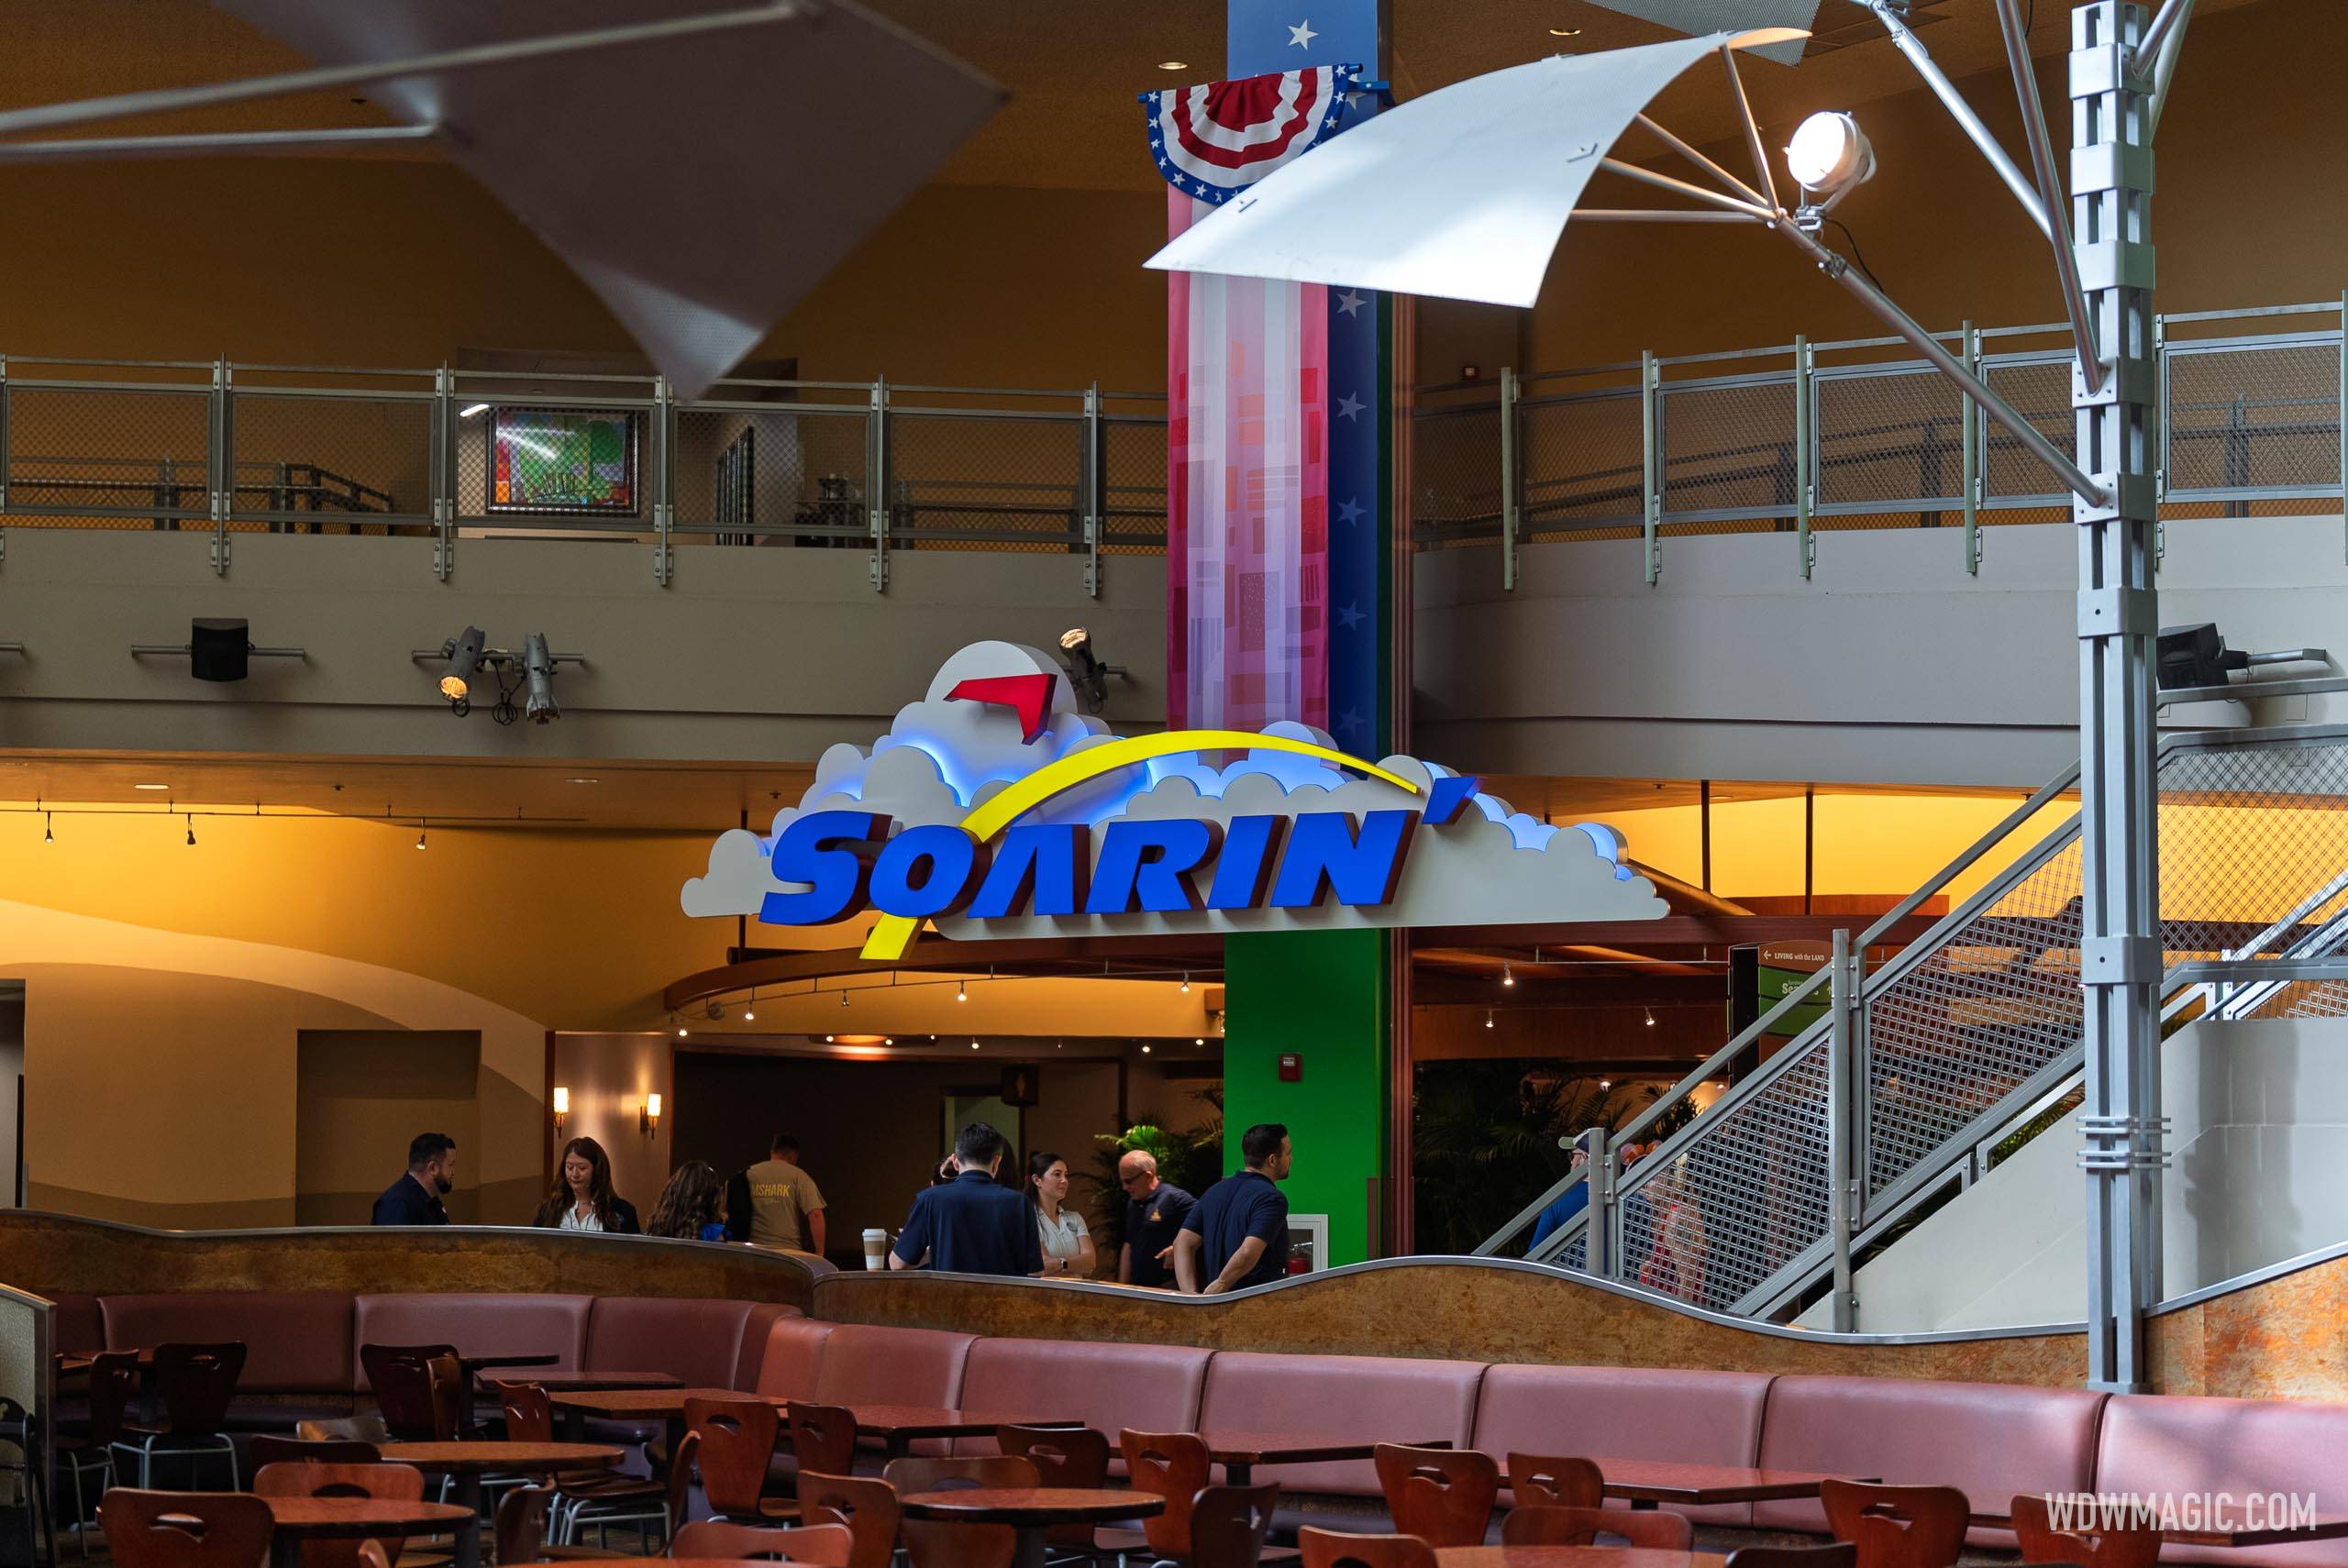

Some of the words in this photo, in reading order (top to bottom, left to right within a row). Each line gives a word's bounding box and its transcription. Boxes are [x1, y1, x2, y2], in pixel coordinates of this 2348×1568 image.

[759, 777, 1479, 925] SOARIN'
[1774, 952, 1793, 960] LIVING
[1794, 953, 1804, 961] with
[1811, 954, 1825, 962] LAND
